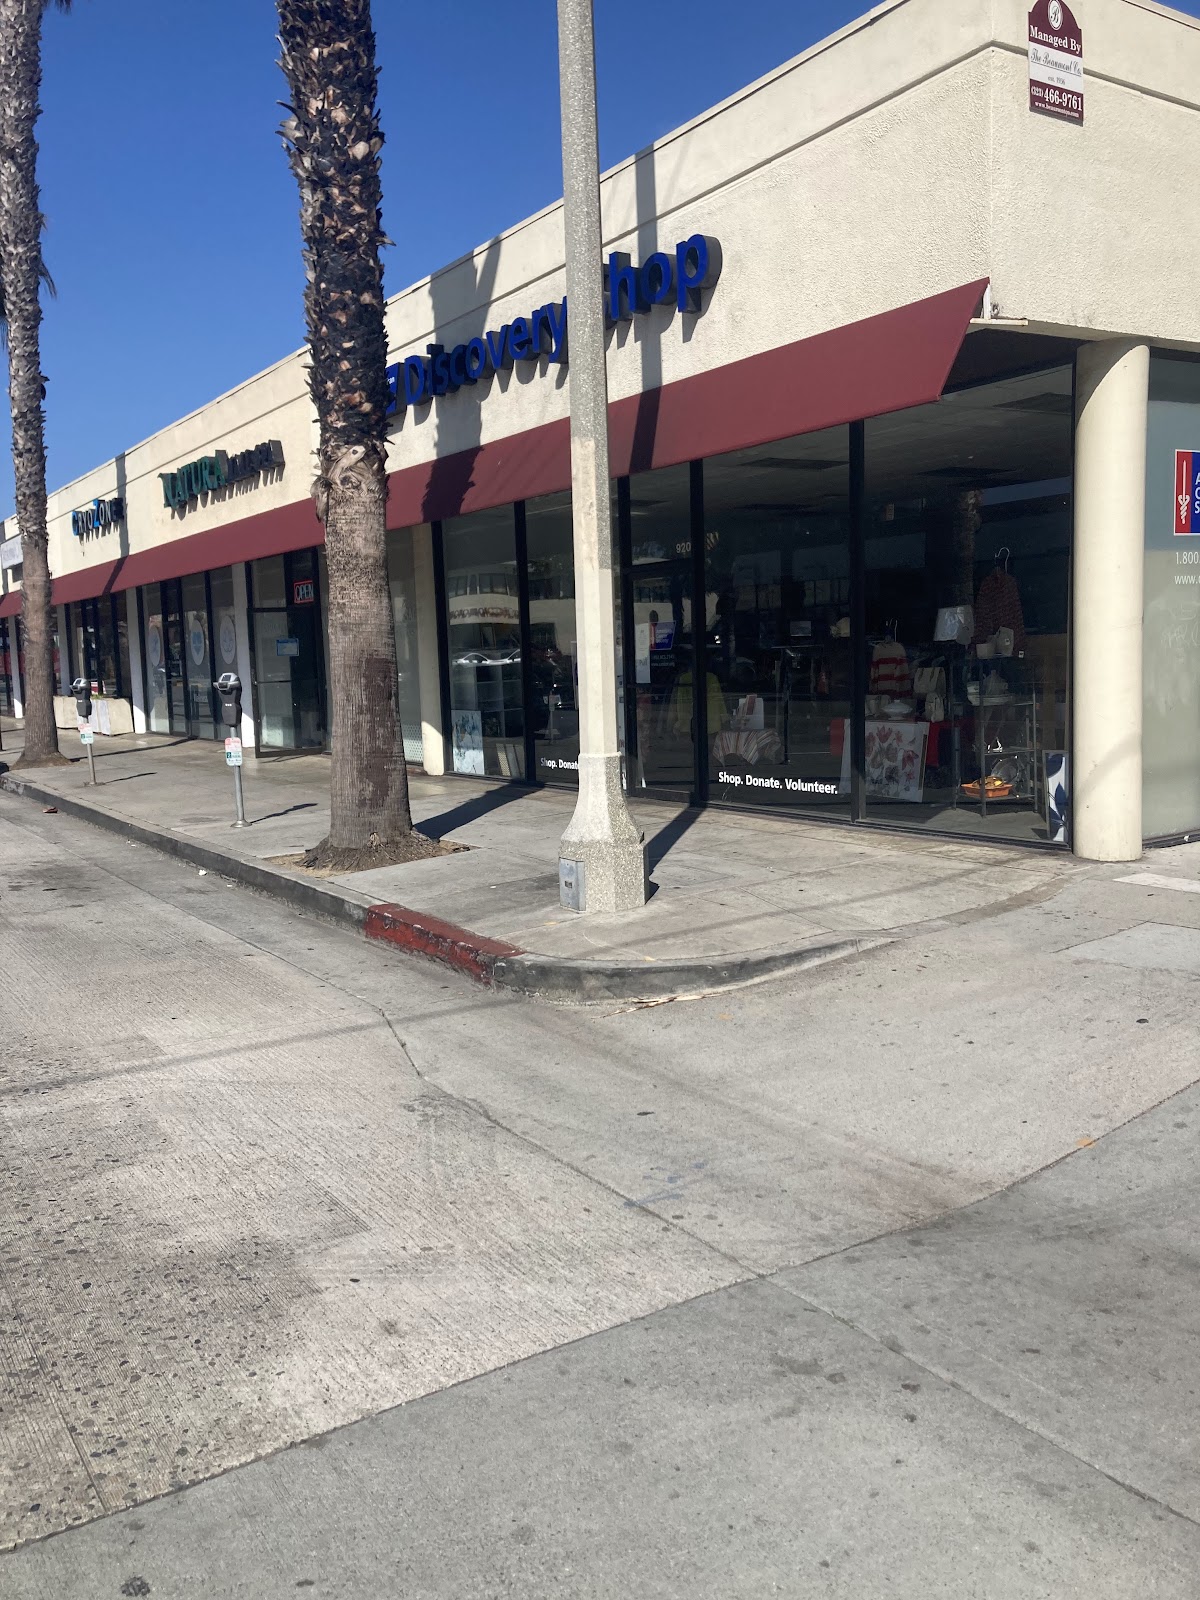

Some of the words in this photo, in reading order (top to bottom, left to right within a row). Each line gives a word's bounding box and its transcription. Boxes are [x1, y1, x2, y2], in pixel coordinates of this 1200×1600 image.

[1030, 25, 1069, 48] Managed
[1070, 38, 1081, 54] By
[1043, 88, 1082, 111] 466-9761
[404, 295, 569, 406] Discovery
[604, 233, 710, 328] hop
[675, 542, 692, 554] 920
[295, 583, 314, 601] OPEN
[540, 757, 558, 770] Shop.
[558, 758, 579, 770] Donat
[718, 771, 744, 787] Shop.
[745, 774, 783, 789] Donate.
[784, 778, 838, 794] Volunteer.
